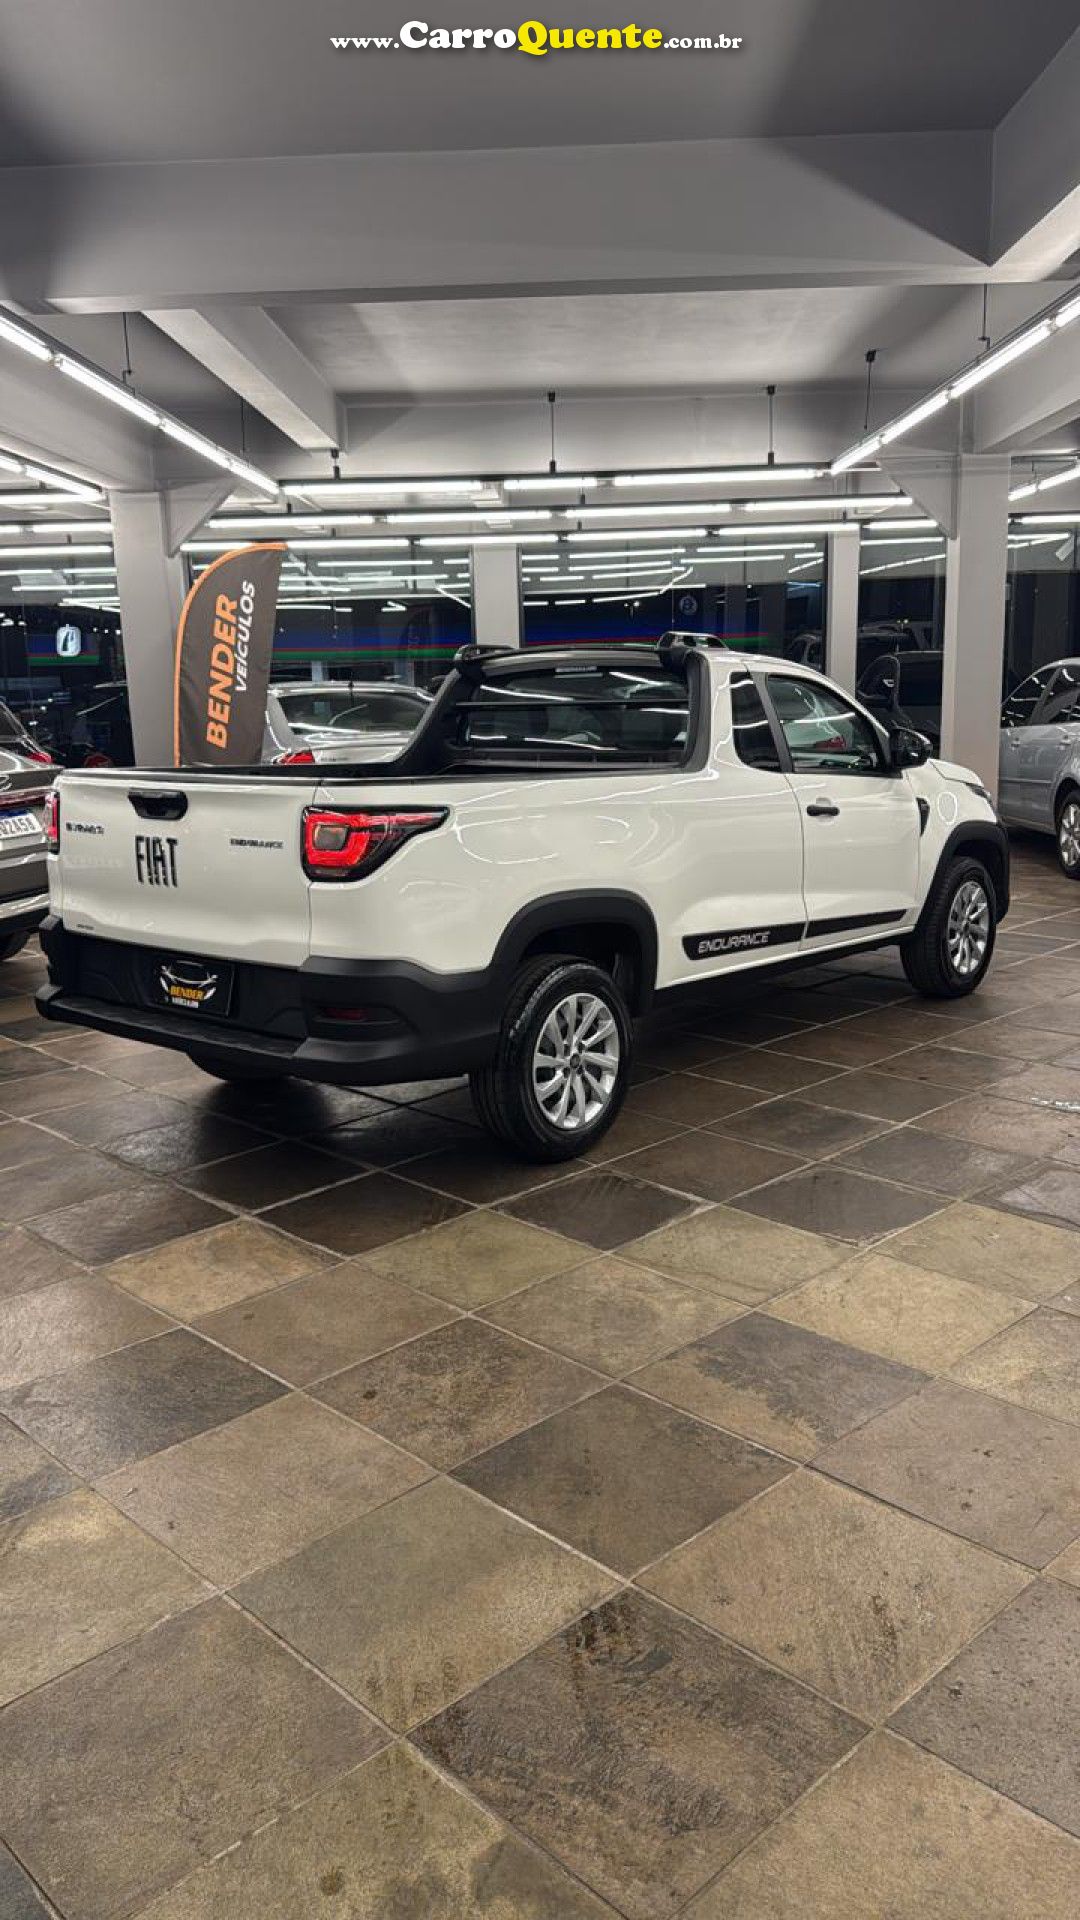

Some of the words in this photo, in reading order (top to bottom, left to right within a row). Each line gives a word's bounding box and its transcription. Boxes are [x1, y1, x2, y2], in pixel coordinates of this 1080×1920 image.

[206, 593, 238, 749] BENDER
[235, 580, 256, 692] VEÍCULOS
[134, 835, 178, 888] FIAT
[698, 930, 771, 955] ENDURANCE
